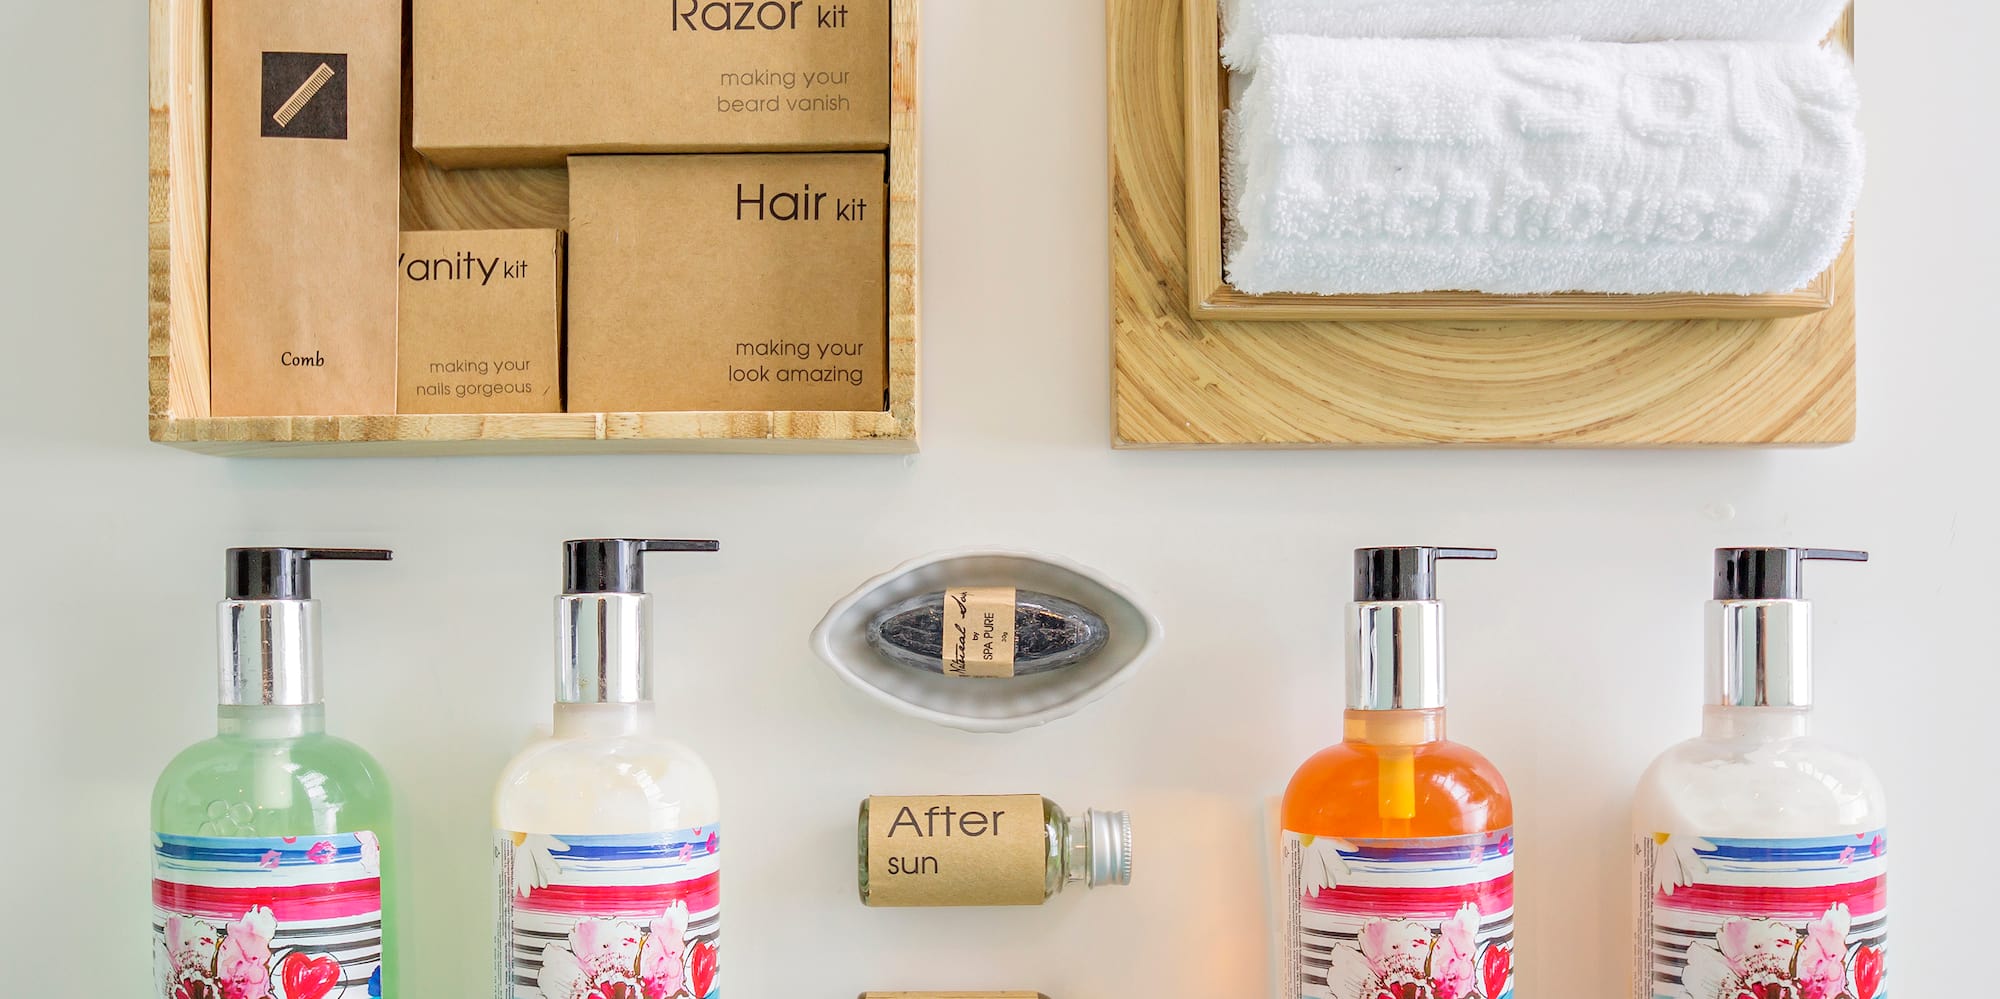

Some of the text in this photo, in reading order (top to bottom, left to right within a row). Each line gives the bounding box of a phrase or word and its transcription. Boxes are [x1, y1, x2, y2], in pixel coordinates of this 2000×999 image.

[672, 0, 849, 32] Razor kit
[720, 69, 851, 90] making your
[717, 93, 851, 113] beard vanish
[735, 183, 867, 222] Hair kit
[398, 250, 529, 287] anity kit
[281, 350, 326, 368] Comb
[735, 339, 865, 360] making your
[429, 359, 531, 376] making your
[728, 364, 864, 387] look amazing
[416, 382, 533, 399] nails gorgeous
[971, 630, 981, 642] by
[983, 612, 996, 661] SPA PURE
[886, 805, 1006, 838] After
[887, 855, 939, 875] sun
